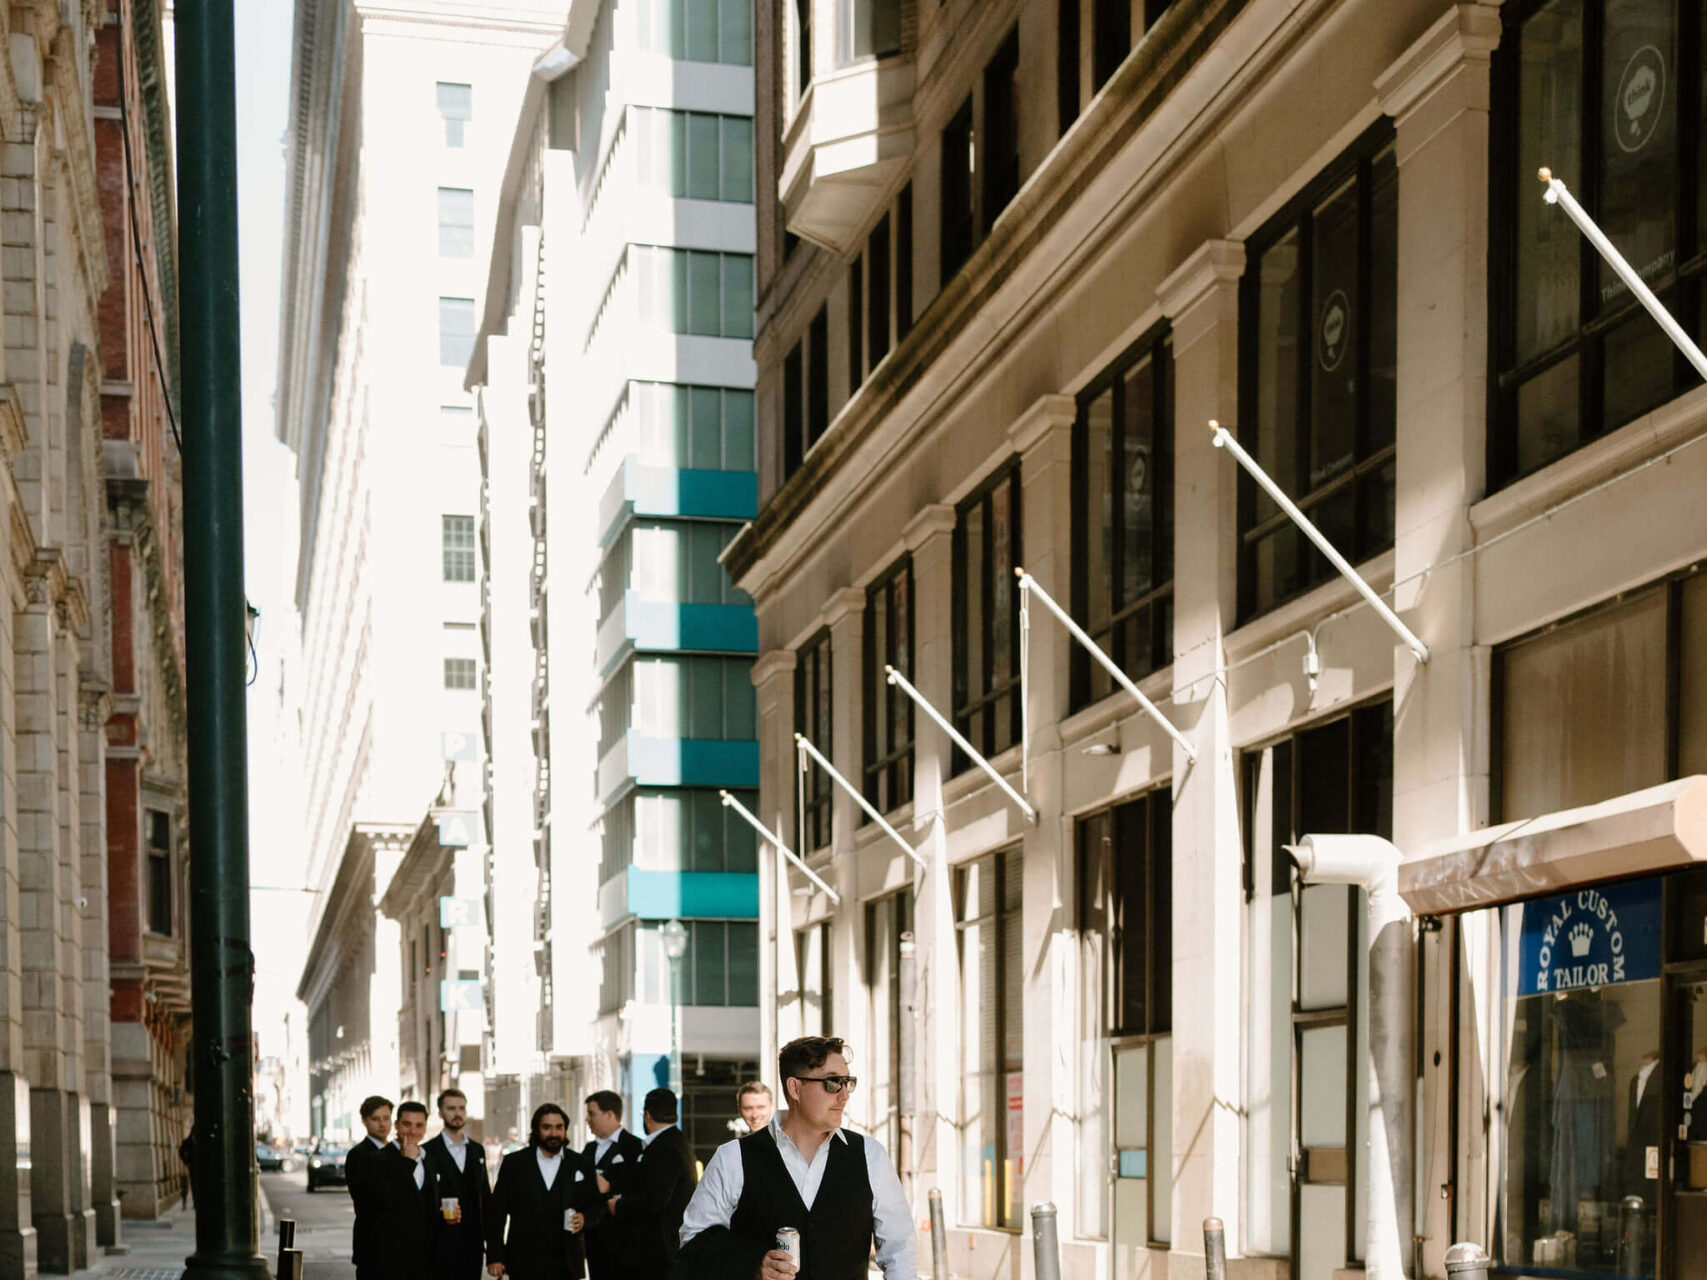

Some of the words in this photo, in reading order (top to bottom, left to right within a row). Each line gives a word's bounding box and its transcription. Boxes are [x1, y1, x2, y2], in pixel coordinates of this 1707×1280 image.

[444, 732, 471, 1008] PARK
[1537, 900, 1572, 992] ROYAL
[1577, 889, 1626, 982] CUSTOM
[1553, 963, 1610, 989] TAILOR
